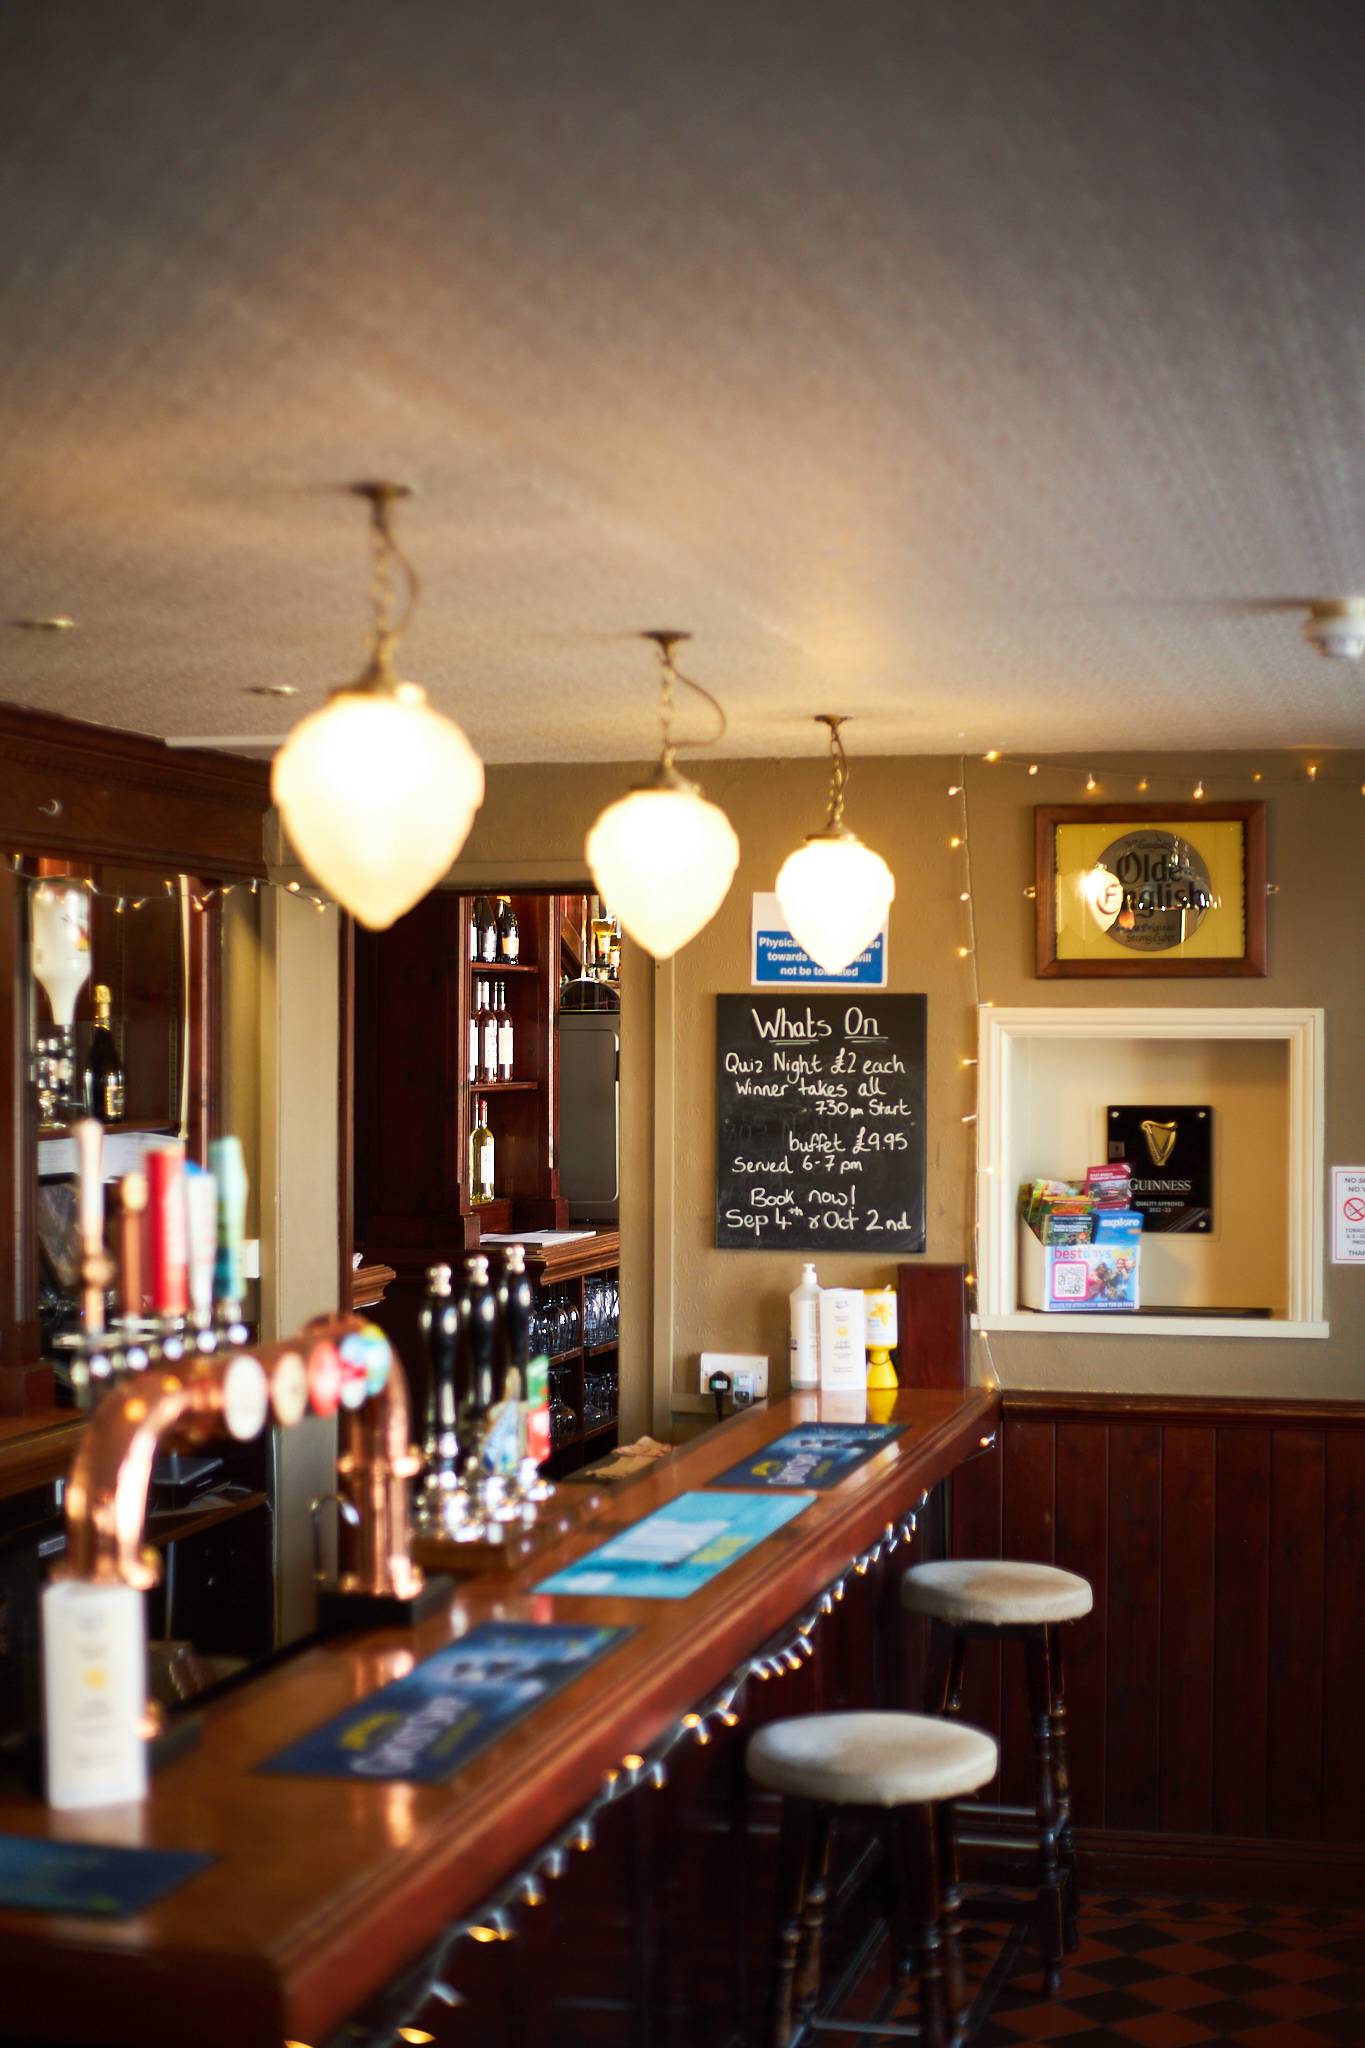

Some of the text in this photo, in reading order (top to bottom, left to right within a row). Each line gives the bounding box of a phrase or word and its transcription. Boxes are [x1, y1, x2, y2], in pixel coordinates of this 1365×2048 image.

[1116, 852, 1183, 883] Olde
[759, 936, 801, 950] Physica
[767, 952, 808, 962] towards
[780, 967, 797, 976] not
[799, 967, 812, 976] be
[752, 1006, 880, 1039] Whats On
[725, 1047, 906, 1085] Quiz Night £2 each
[798, 1078, 848, 1097] takes
[857, 1076, 888, 1097] all
[789, 1126, 908, 1154] buffet £9.95
[731, 1156, 794, 1174] Served
[1129, 1178, 1193, 1191] GUINNESS
[750, 1185, 857, 1210] Book now!
[725, 1209, 769, 1236] Sep
[1101, 1217, 1140, 1229] explore
